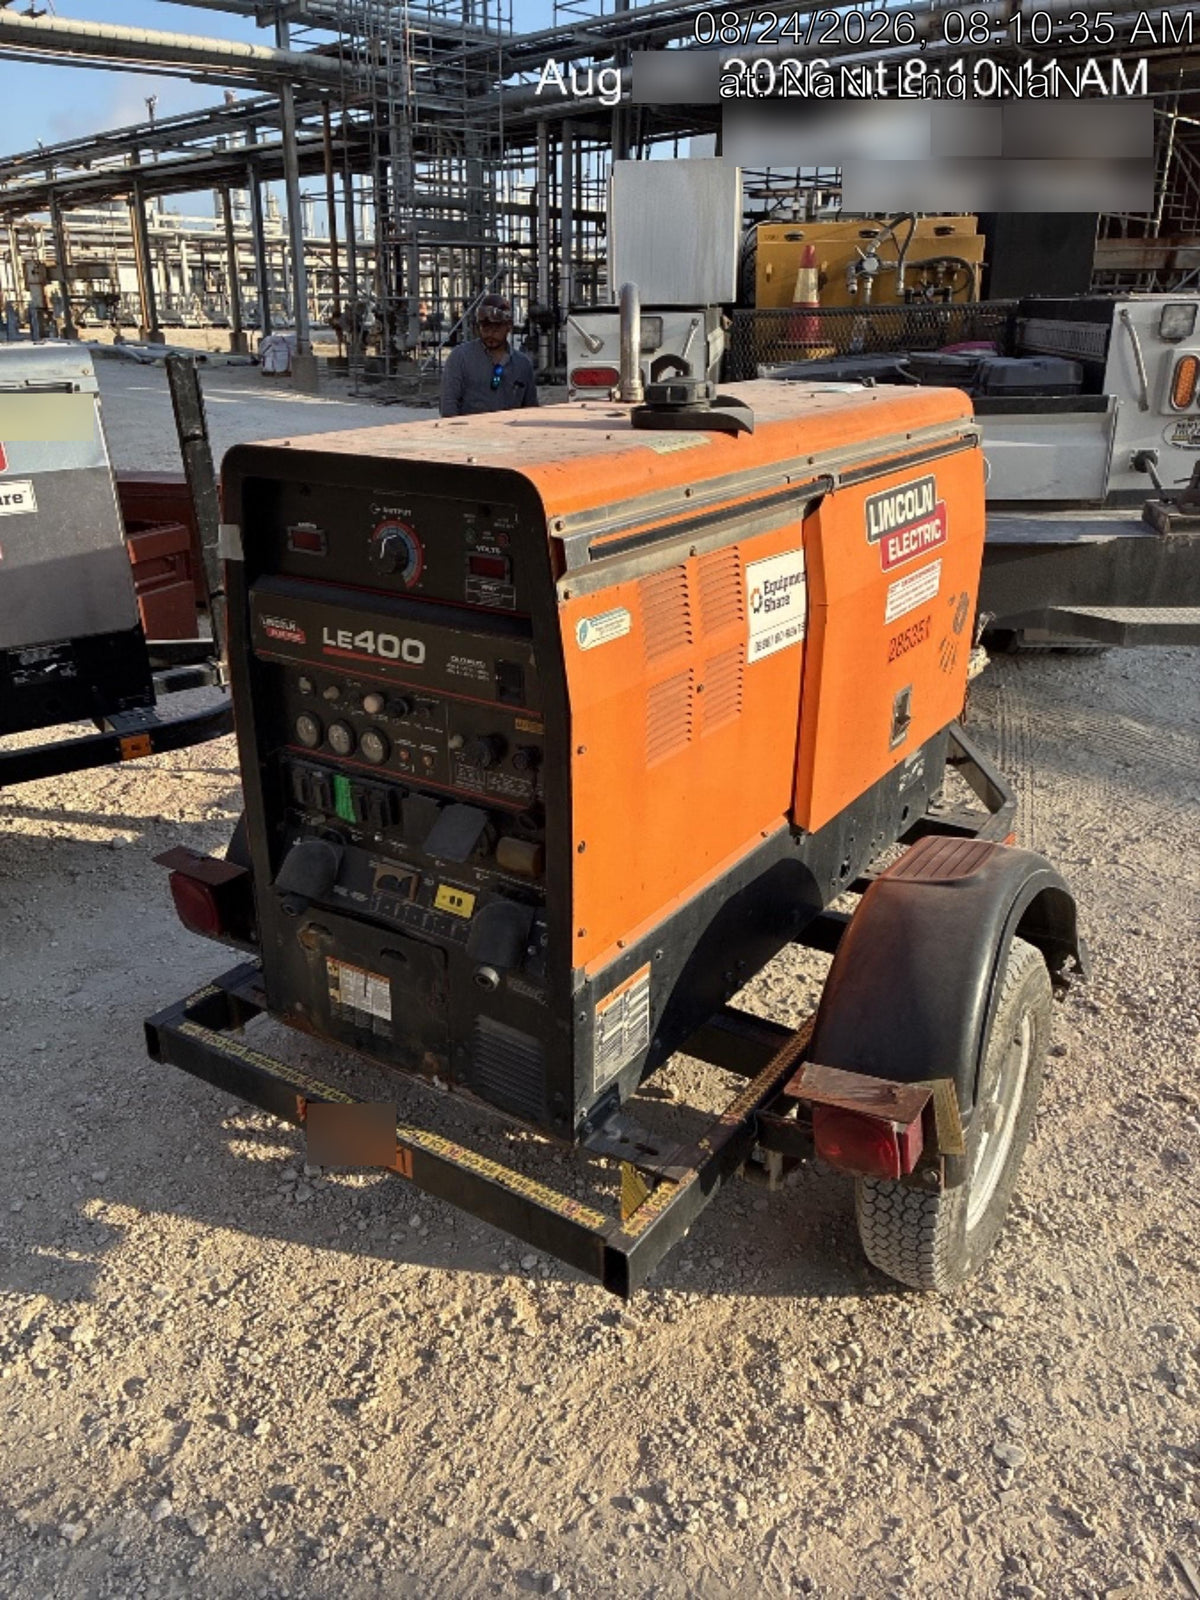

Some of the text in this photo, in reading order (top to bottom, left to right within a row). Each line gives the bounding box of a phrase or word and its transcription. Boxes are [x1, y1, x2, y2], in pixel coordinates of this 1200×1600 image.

[868, 482, 934, 536] LINCOLN
[887, 519, 942, 562] ELECTRIC
[764, 594, 791, 614] Share
[322, 627, 426, 664] LE400
